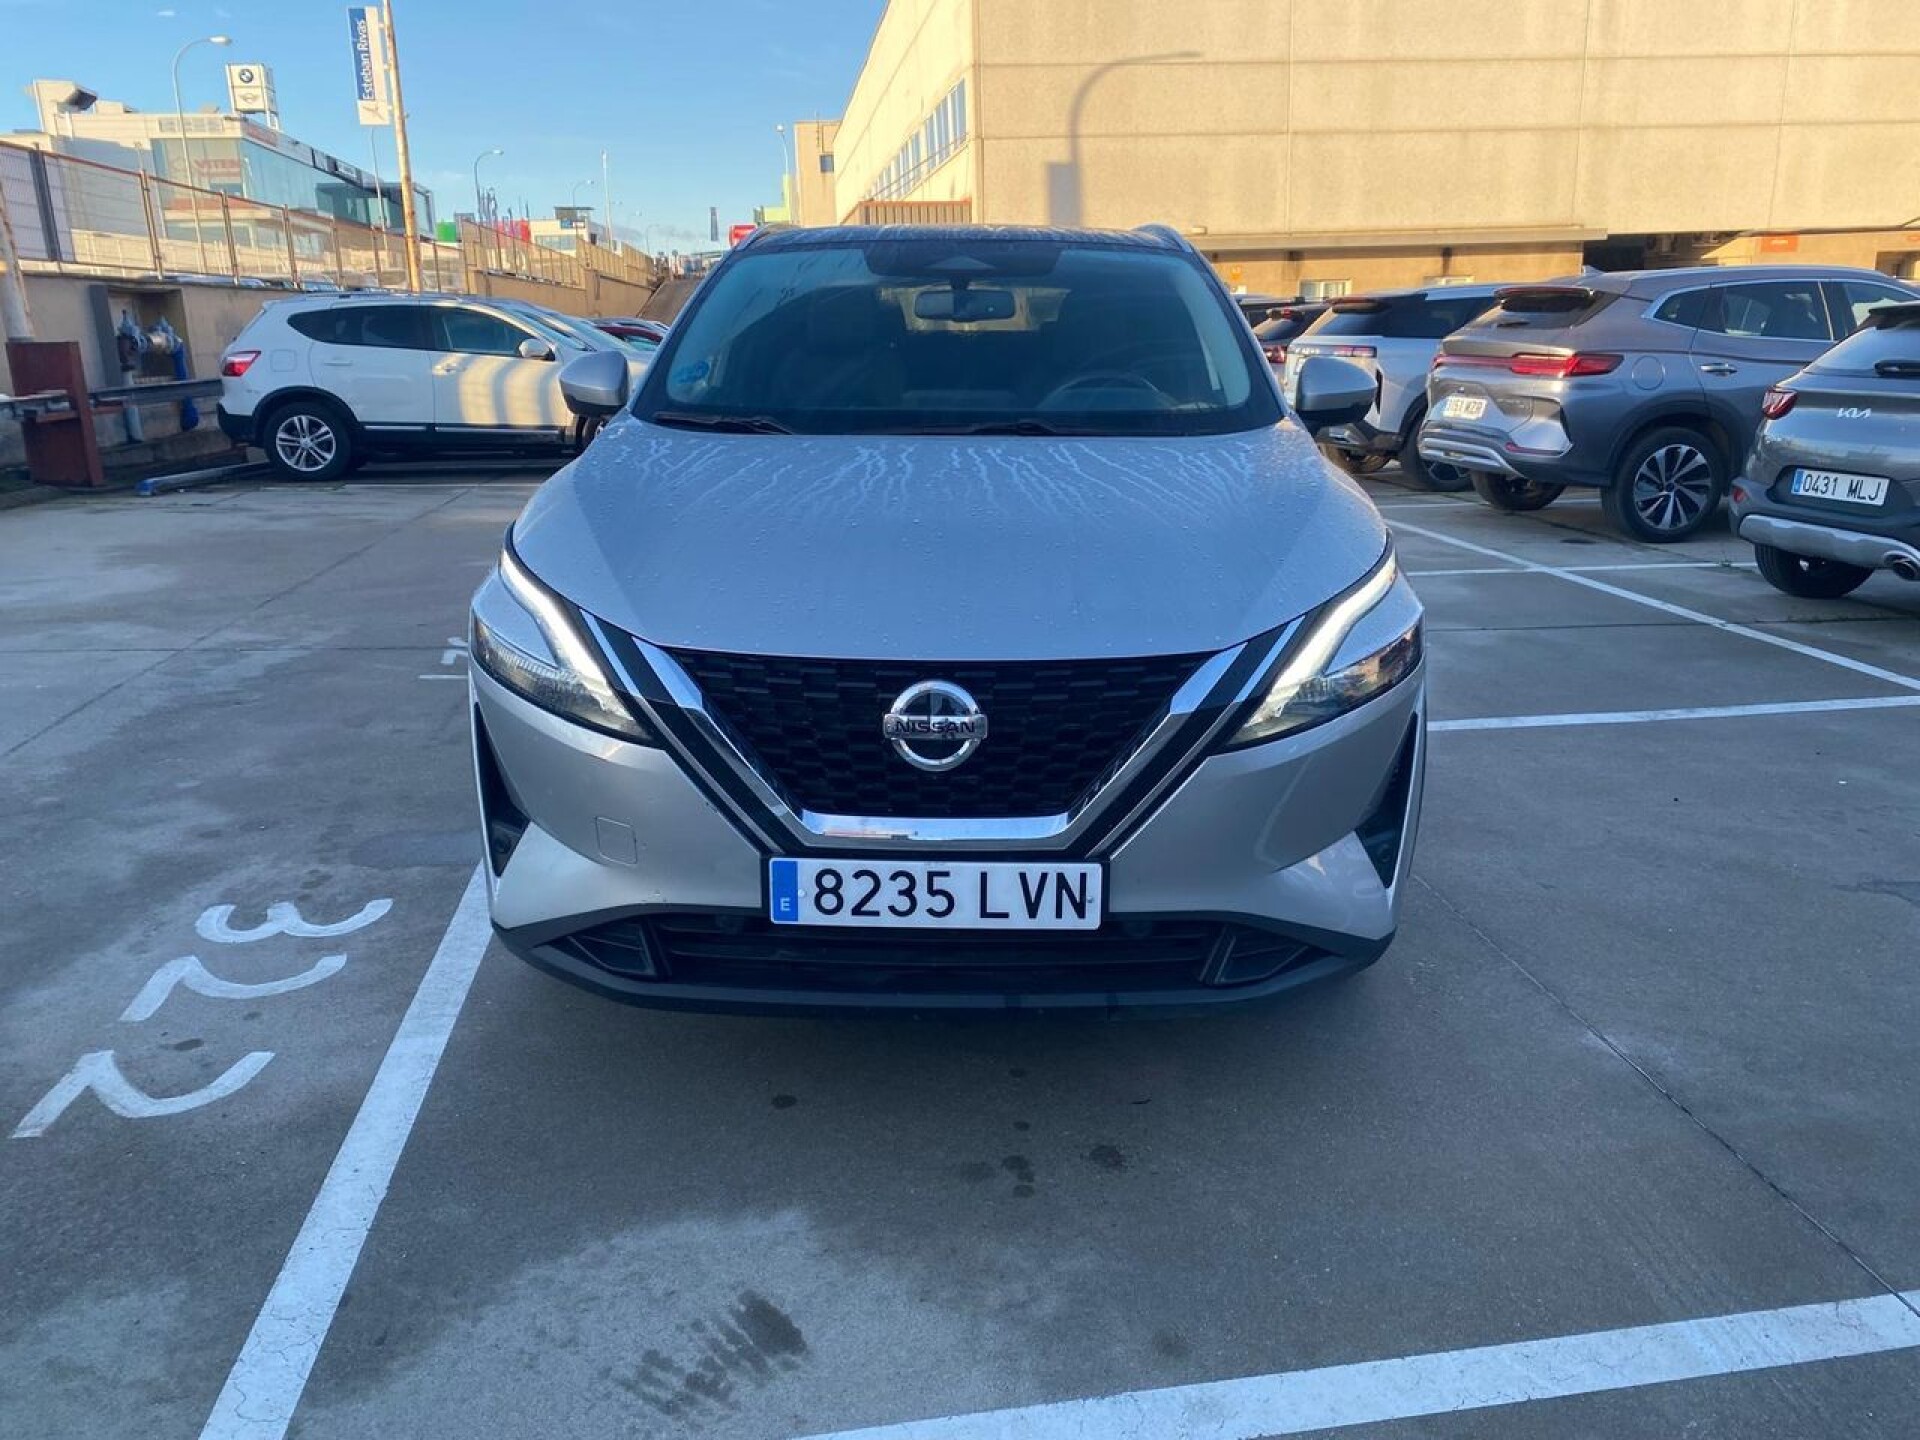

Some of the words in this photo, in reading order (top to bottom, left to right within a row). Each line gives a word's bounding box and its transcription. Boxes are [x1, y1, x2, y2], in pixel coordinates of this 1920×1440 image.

[356, 19, 369, 51] Rivas
[360, 53, 374, 100] Esteban
[1837, 408, 1871, 418] KIA
[1803, 474, 1838, 496] 0431
[1847, 479, 1882, 501] MLJ
[896, 720, 976, 734] NISSAN
[780, 897, 791, 912] E
[814, 867, 955, 919] 8235
[979, 870, 1087, 919] LVN
